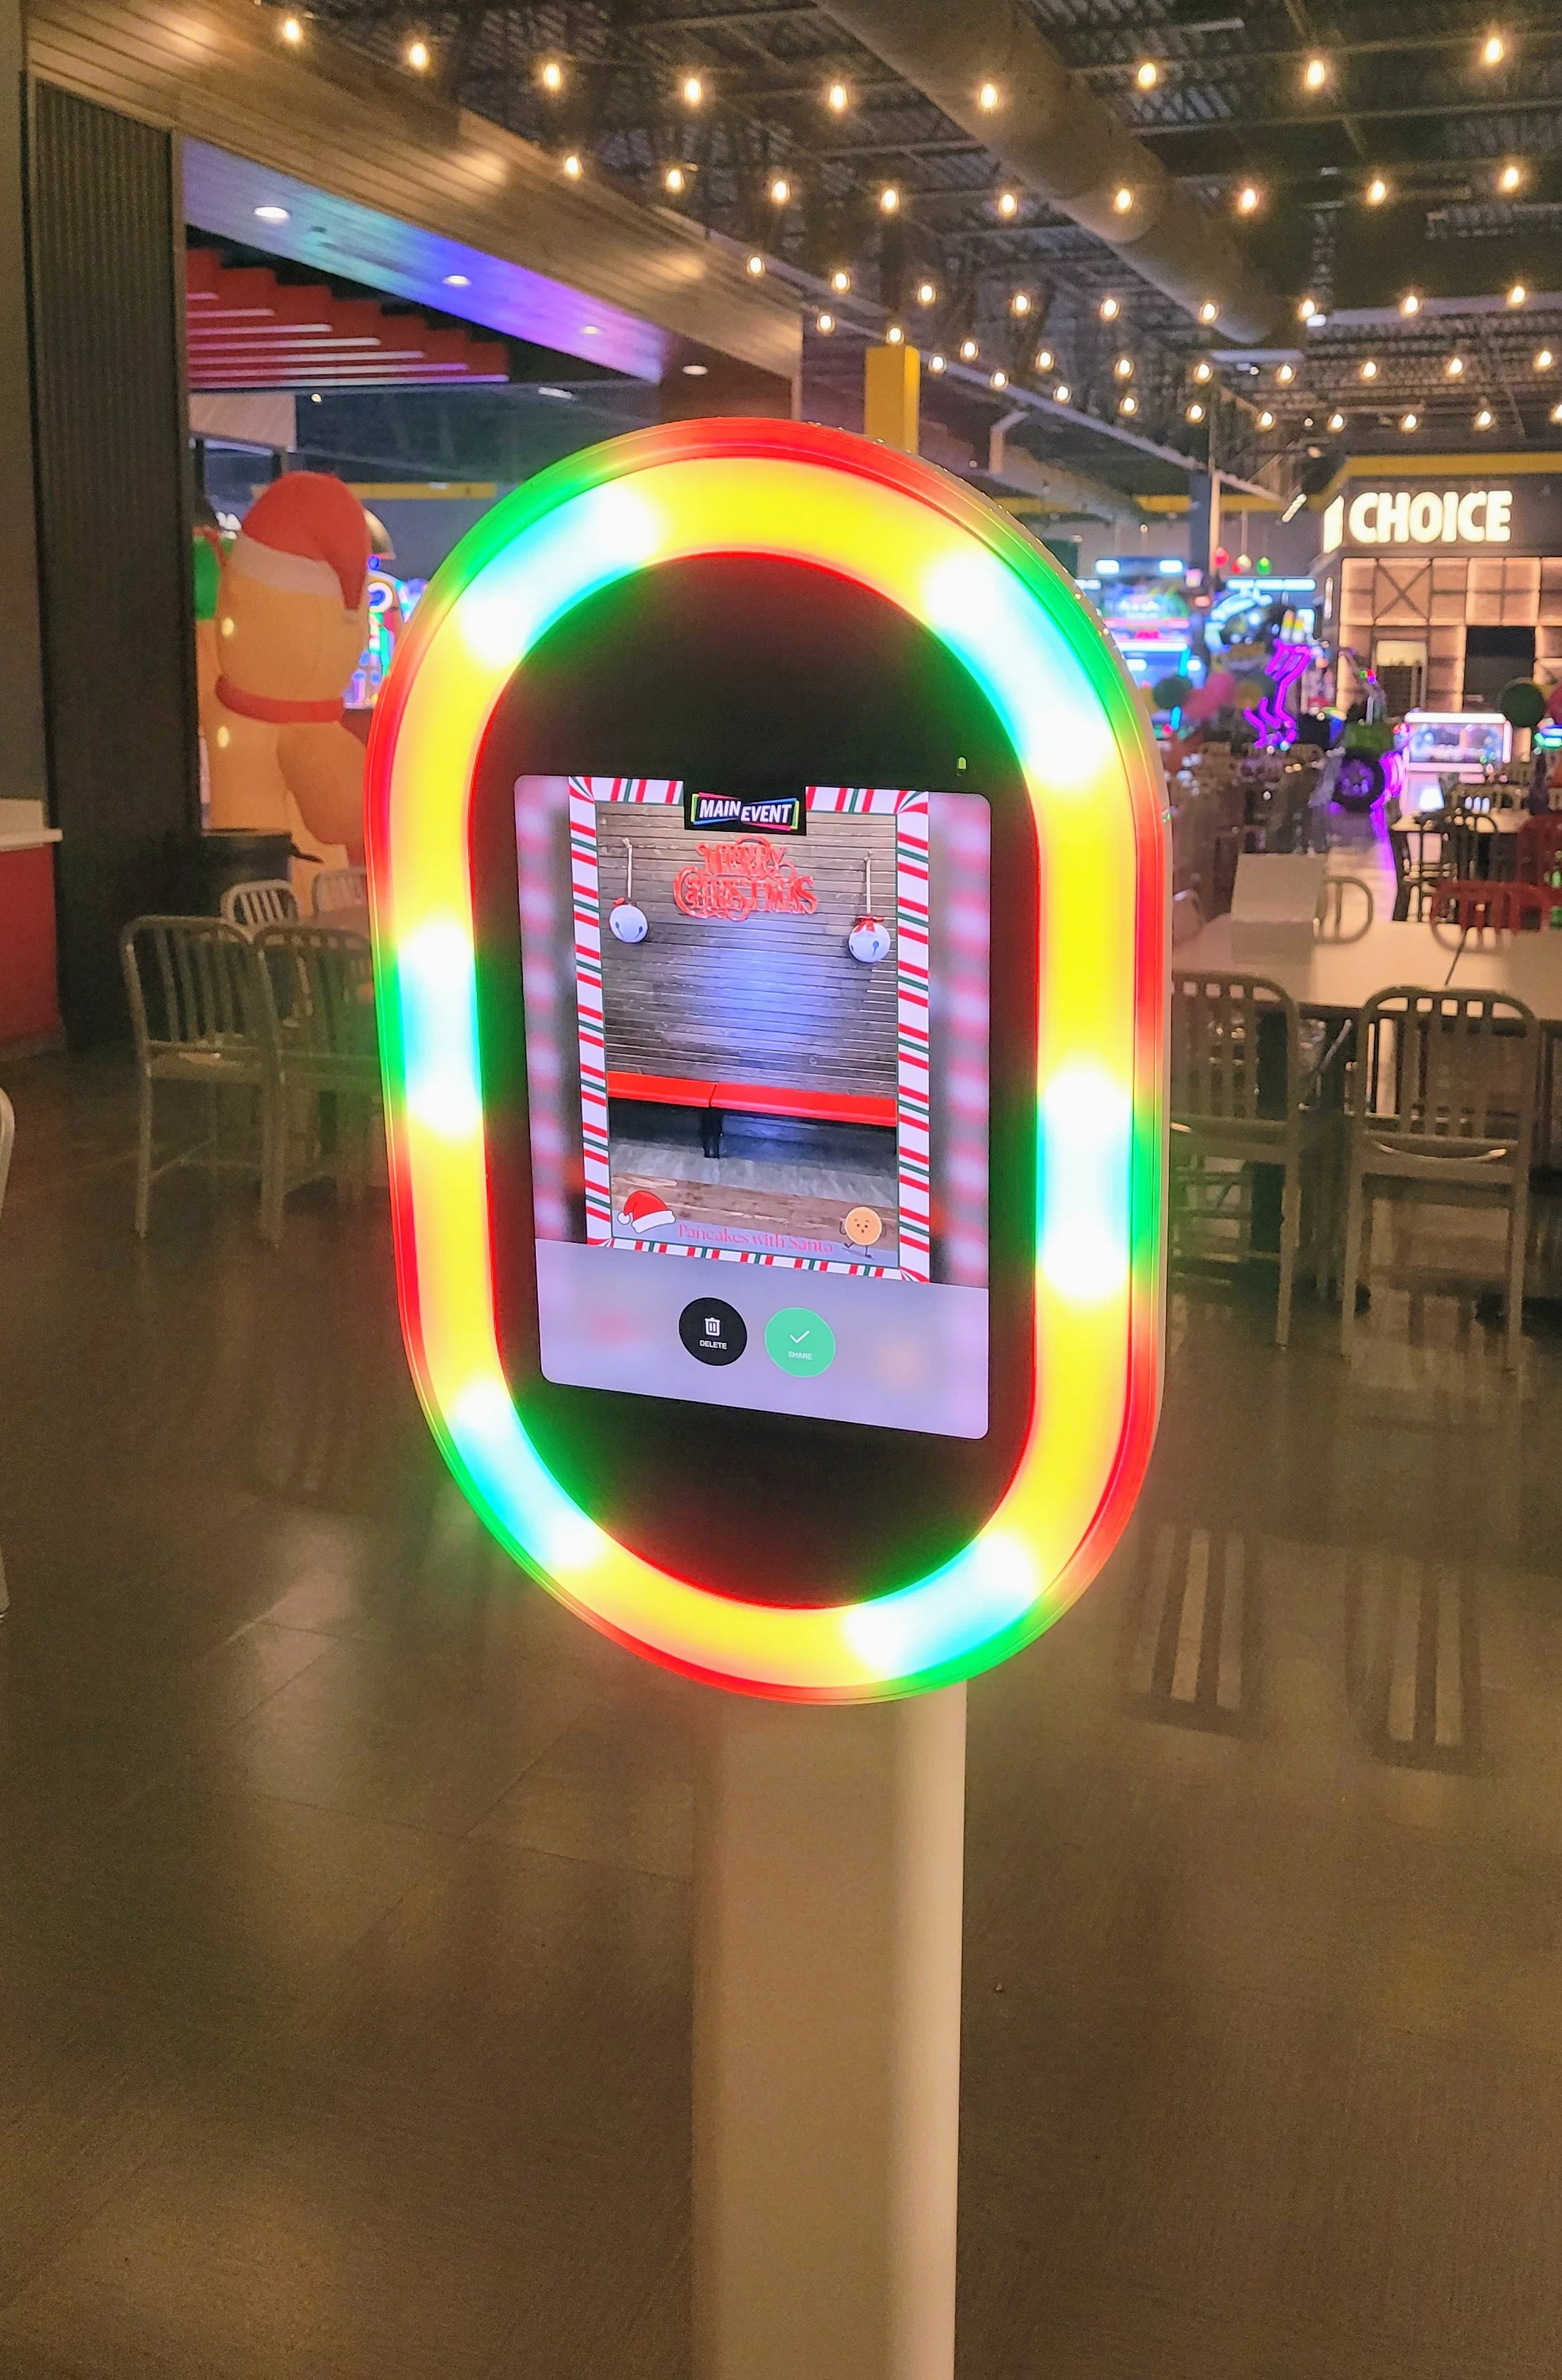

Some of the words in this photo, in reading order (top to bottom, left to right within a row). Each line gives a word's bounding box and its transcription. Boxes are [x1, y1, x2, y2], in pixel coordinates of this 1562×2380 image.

[1348, 490, 1513, 543] CHOICE
[699, 799, 742, 818] MAIN
[740, 804, 792, 823] EVENT
[678, 1224, 749, 1244] Pancakes
[752, 1233, 785, 1248] with
[789, 1236, 833, 1254] Santa
[699, 1339, 727, 1349] DELETE
[788, 1351, 813, 1360] SHARE
